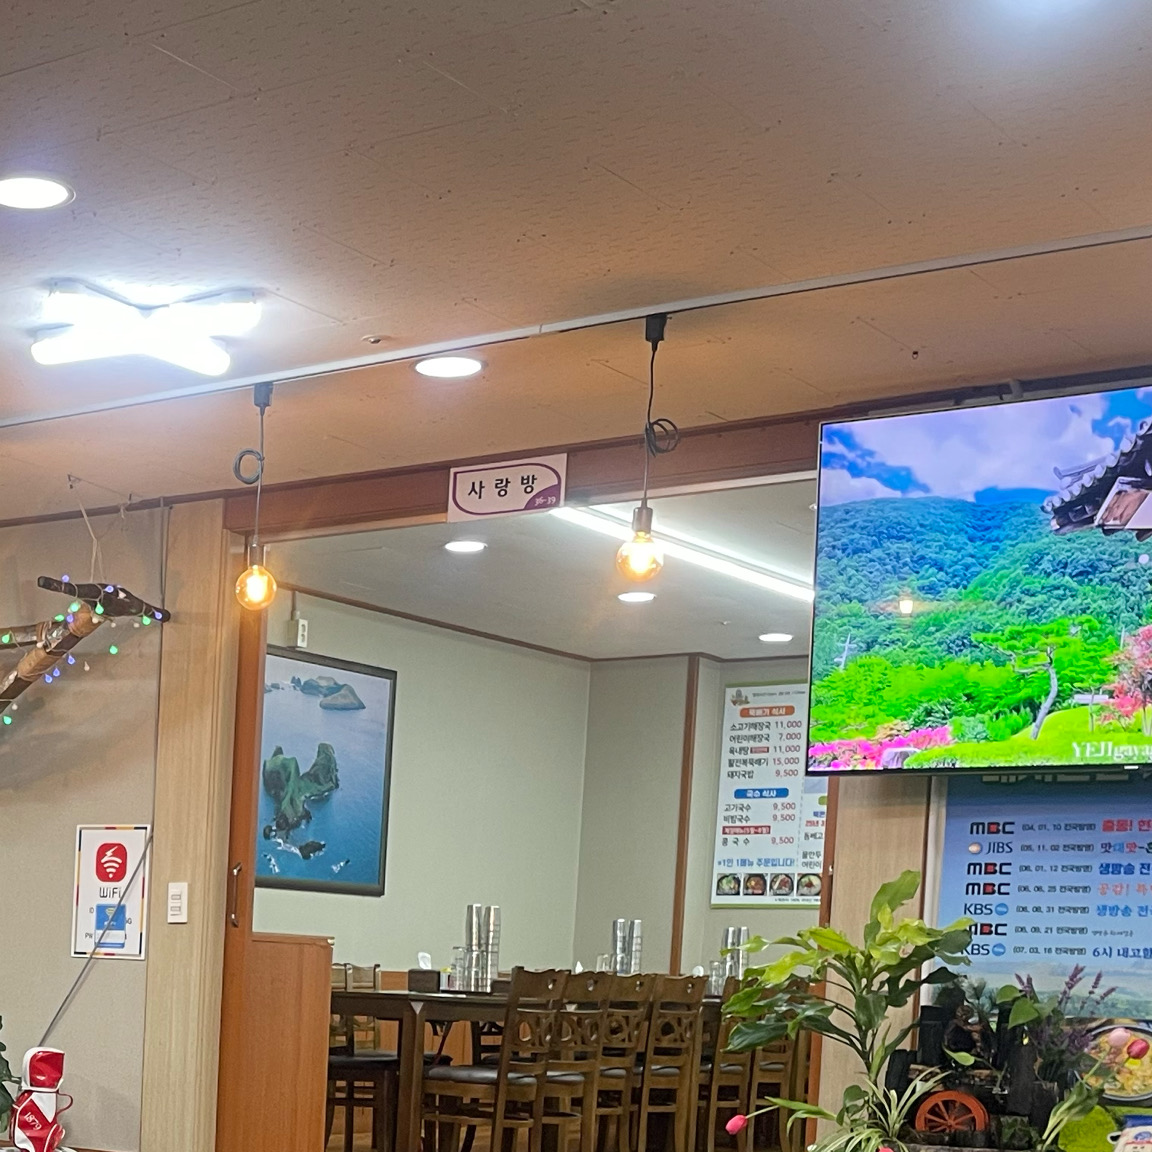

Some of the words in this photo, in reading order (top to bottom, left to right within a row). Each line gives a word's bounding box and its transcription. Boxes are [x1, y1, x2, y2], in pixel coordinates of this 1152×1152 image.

[468, 475, 538, 500] 사랑방
[775, 720, 802, 730] 11,000
[779, 733, 801, 742] 7,000
[773, 745, 800, 754] 11,000
[773, 757, 799, 766] 15,000
[776, 769, 798, 778] 9,500
[724, 803, 751, 812] 고기국수
[773, 802, 796, 812] 9,500
[723, 814, 750, 823] 비빔국수
[772, 813, 795, 823] 9,500
[970, 822, 1015, 834] MBC
[771, 837, 794, 845] 9,500
[986, 842, 1013, 854] JIBS
[967, 863, 1012, 875] MBC
[1099, 862, 1135, 875] 생방송
[100, 887, 121, 898] WiFi
[965, 883, 1010, 895] MBC
[964, 903, 993, 915] KBS
[1097, 905, 1132, 917] 생방송
[1092, 946, 1113, 958] 6시
[24, 1112, 42, 1131] 1879
